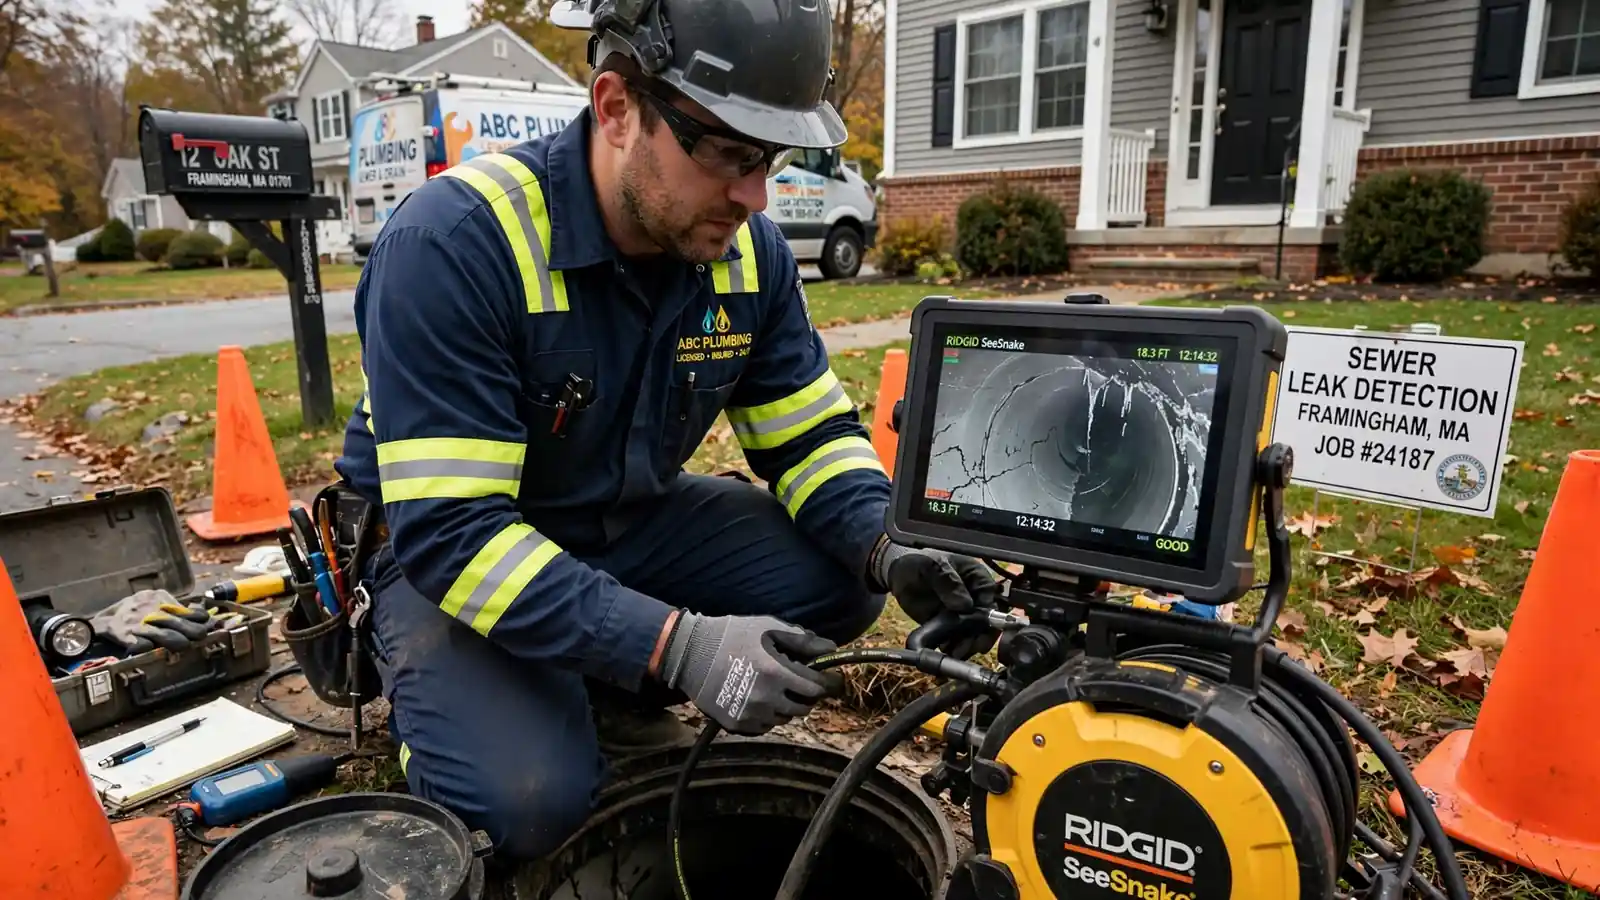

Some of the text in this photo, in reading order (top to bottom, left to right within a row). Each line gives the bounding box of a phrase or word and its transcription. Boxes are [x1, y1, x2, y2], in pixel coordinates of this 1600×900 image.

[480, 113, 521, 139] ABC
[258, 146, 280, 171] ST
[187, 172, 292, 188] FRAMINGHAM, MA 01701
[677, 332, 752, 350] ABC PLUMBING
[981, 336, 1025, 350] SeeSnake
[676, 352, 705, 362] LICENSED
[1136, 347, 1171, 359] 18.3 FT
[1178, 350, 1218, 362] 12:14:32
[1347, 346, 1437, 377] SEWER
[1287, 370, 1499, 416] LEAK DETECTION
[1297, 402, 1470, 443] FRAMINGHAM, MA
[1314, 435, 1435, 471] JOB #24187
[927, 501, 947, 514] 18.3
[948, 504, 961, 516] FT
[1015, 515, 1056, 532] 12:14:32
[1155, 538, 1190, 553] GOOD
[1064, 812, 1196, 872] RIDGID
